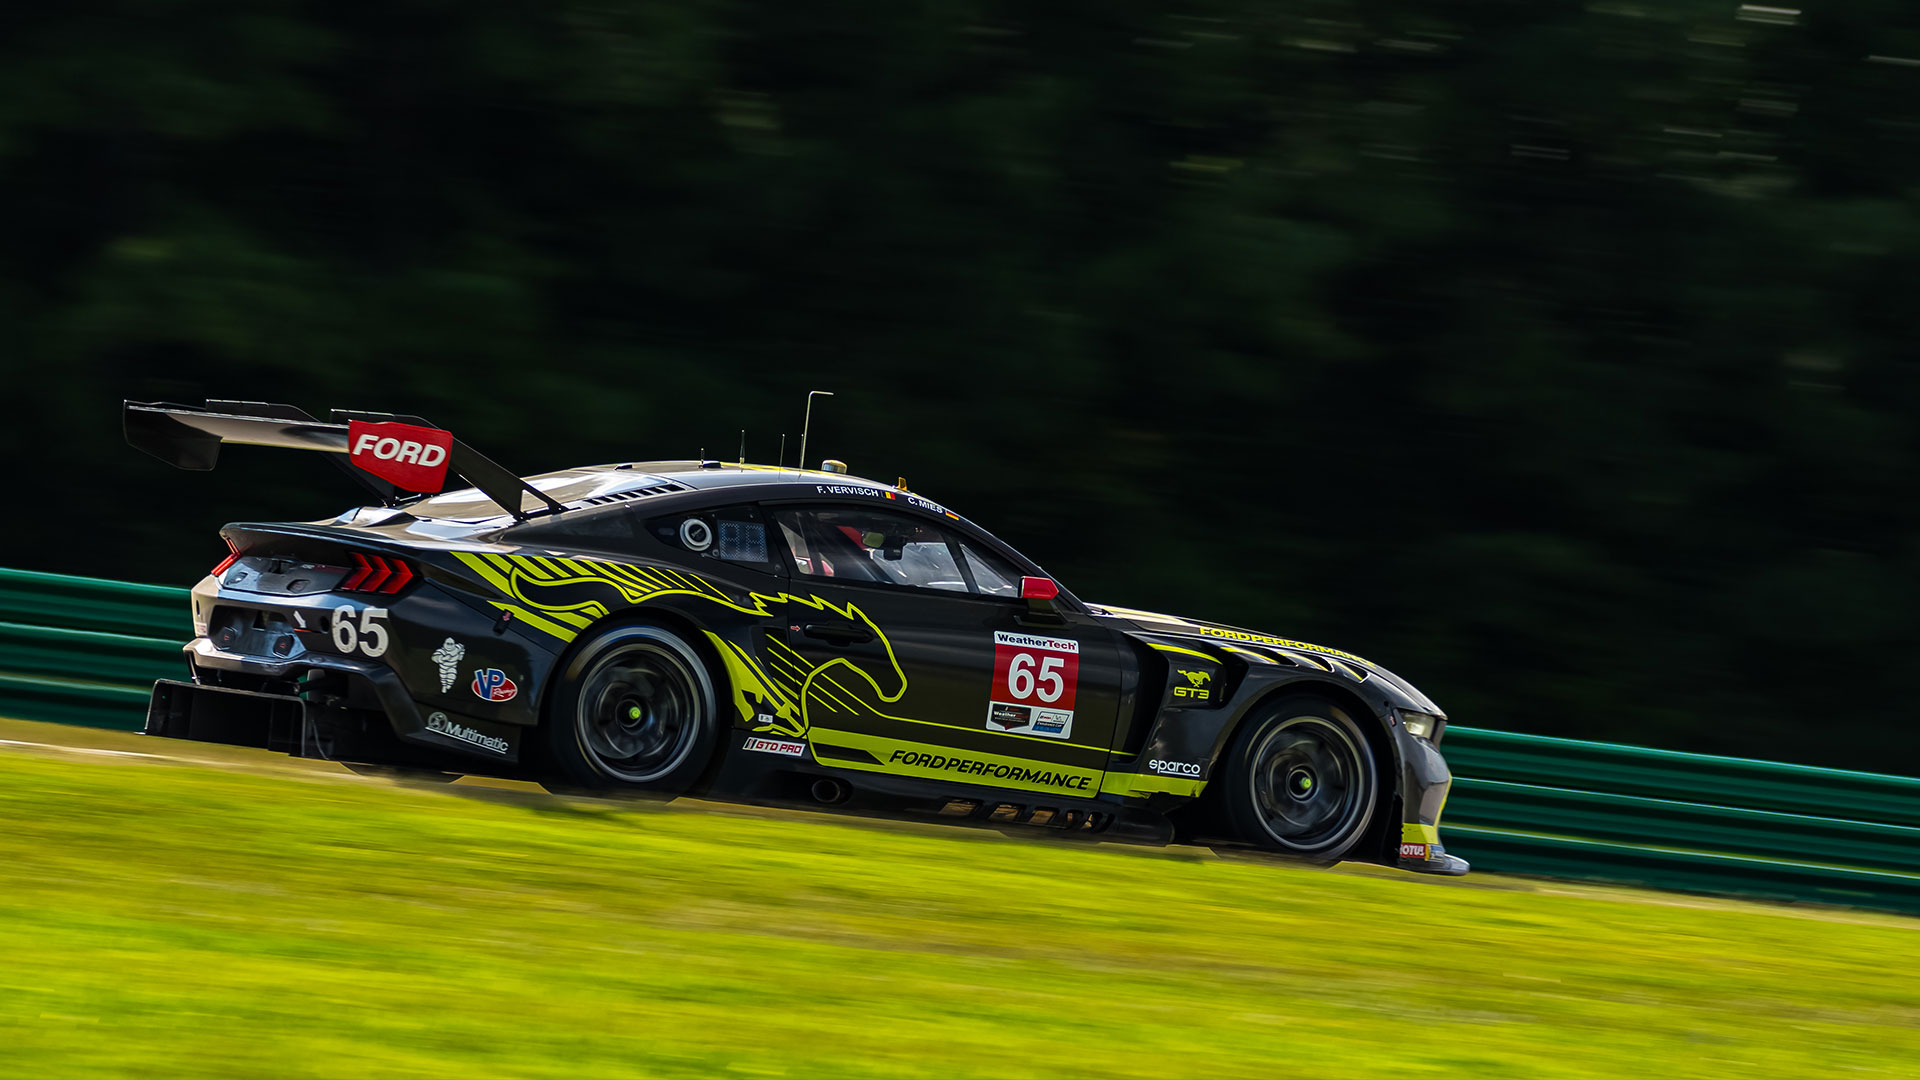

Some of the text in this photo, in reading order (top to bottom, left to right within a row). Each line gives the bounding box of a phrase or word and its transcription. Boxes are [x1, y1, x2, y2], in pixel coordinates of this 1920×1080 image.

[352, 434, 446, 467] FORD
[816, 485, 878, 497] F. VERVISCH
[907, 497, 943, 513] C. MIES
[332, 605, 389, 658] 65
[474, 668, 506, 699] VP
[1008, 653, 1064, 703] 65
[1174, 686, 1210, 700] GT3
[445, 721, 509, 752] Multimatic
[755, 741, 802, 754] GTD PRO
[889, 750, 1092, 790] FORDPERFORMANCE
[1149, 759, 1201, 775] sparco
